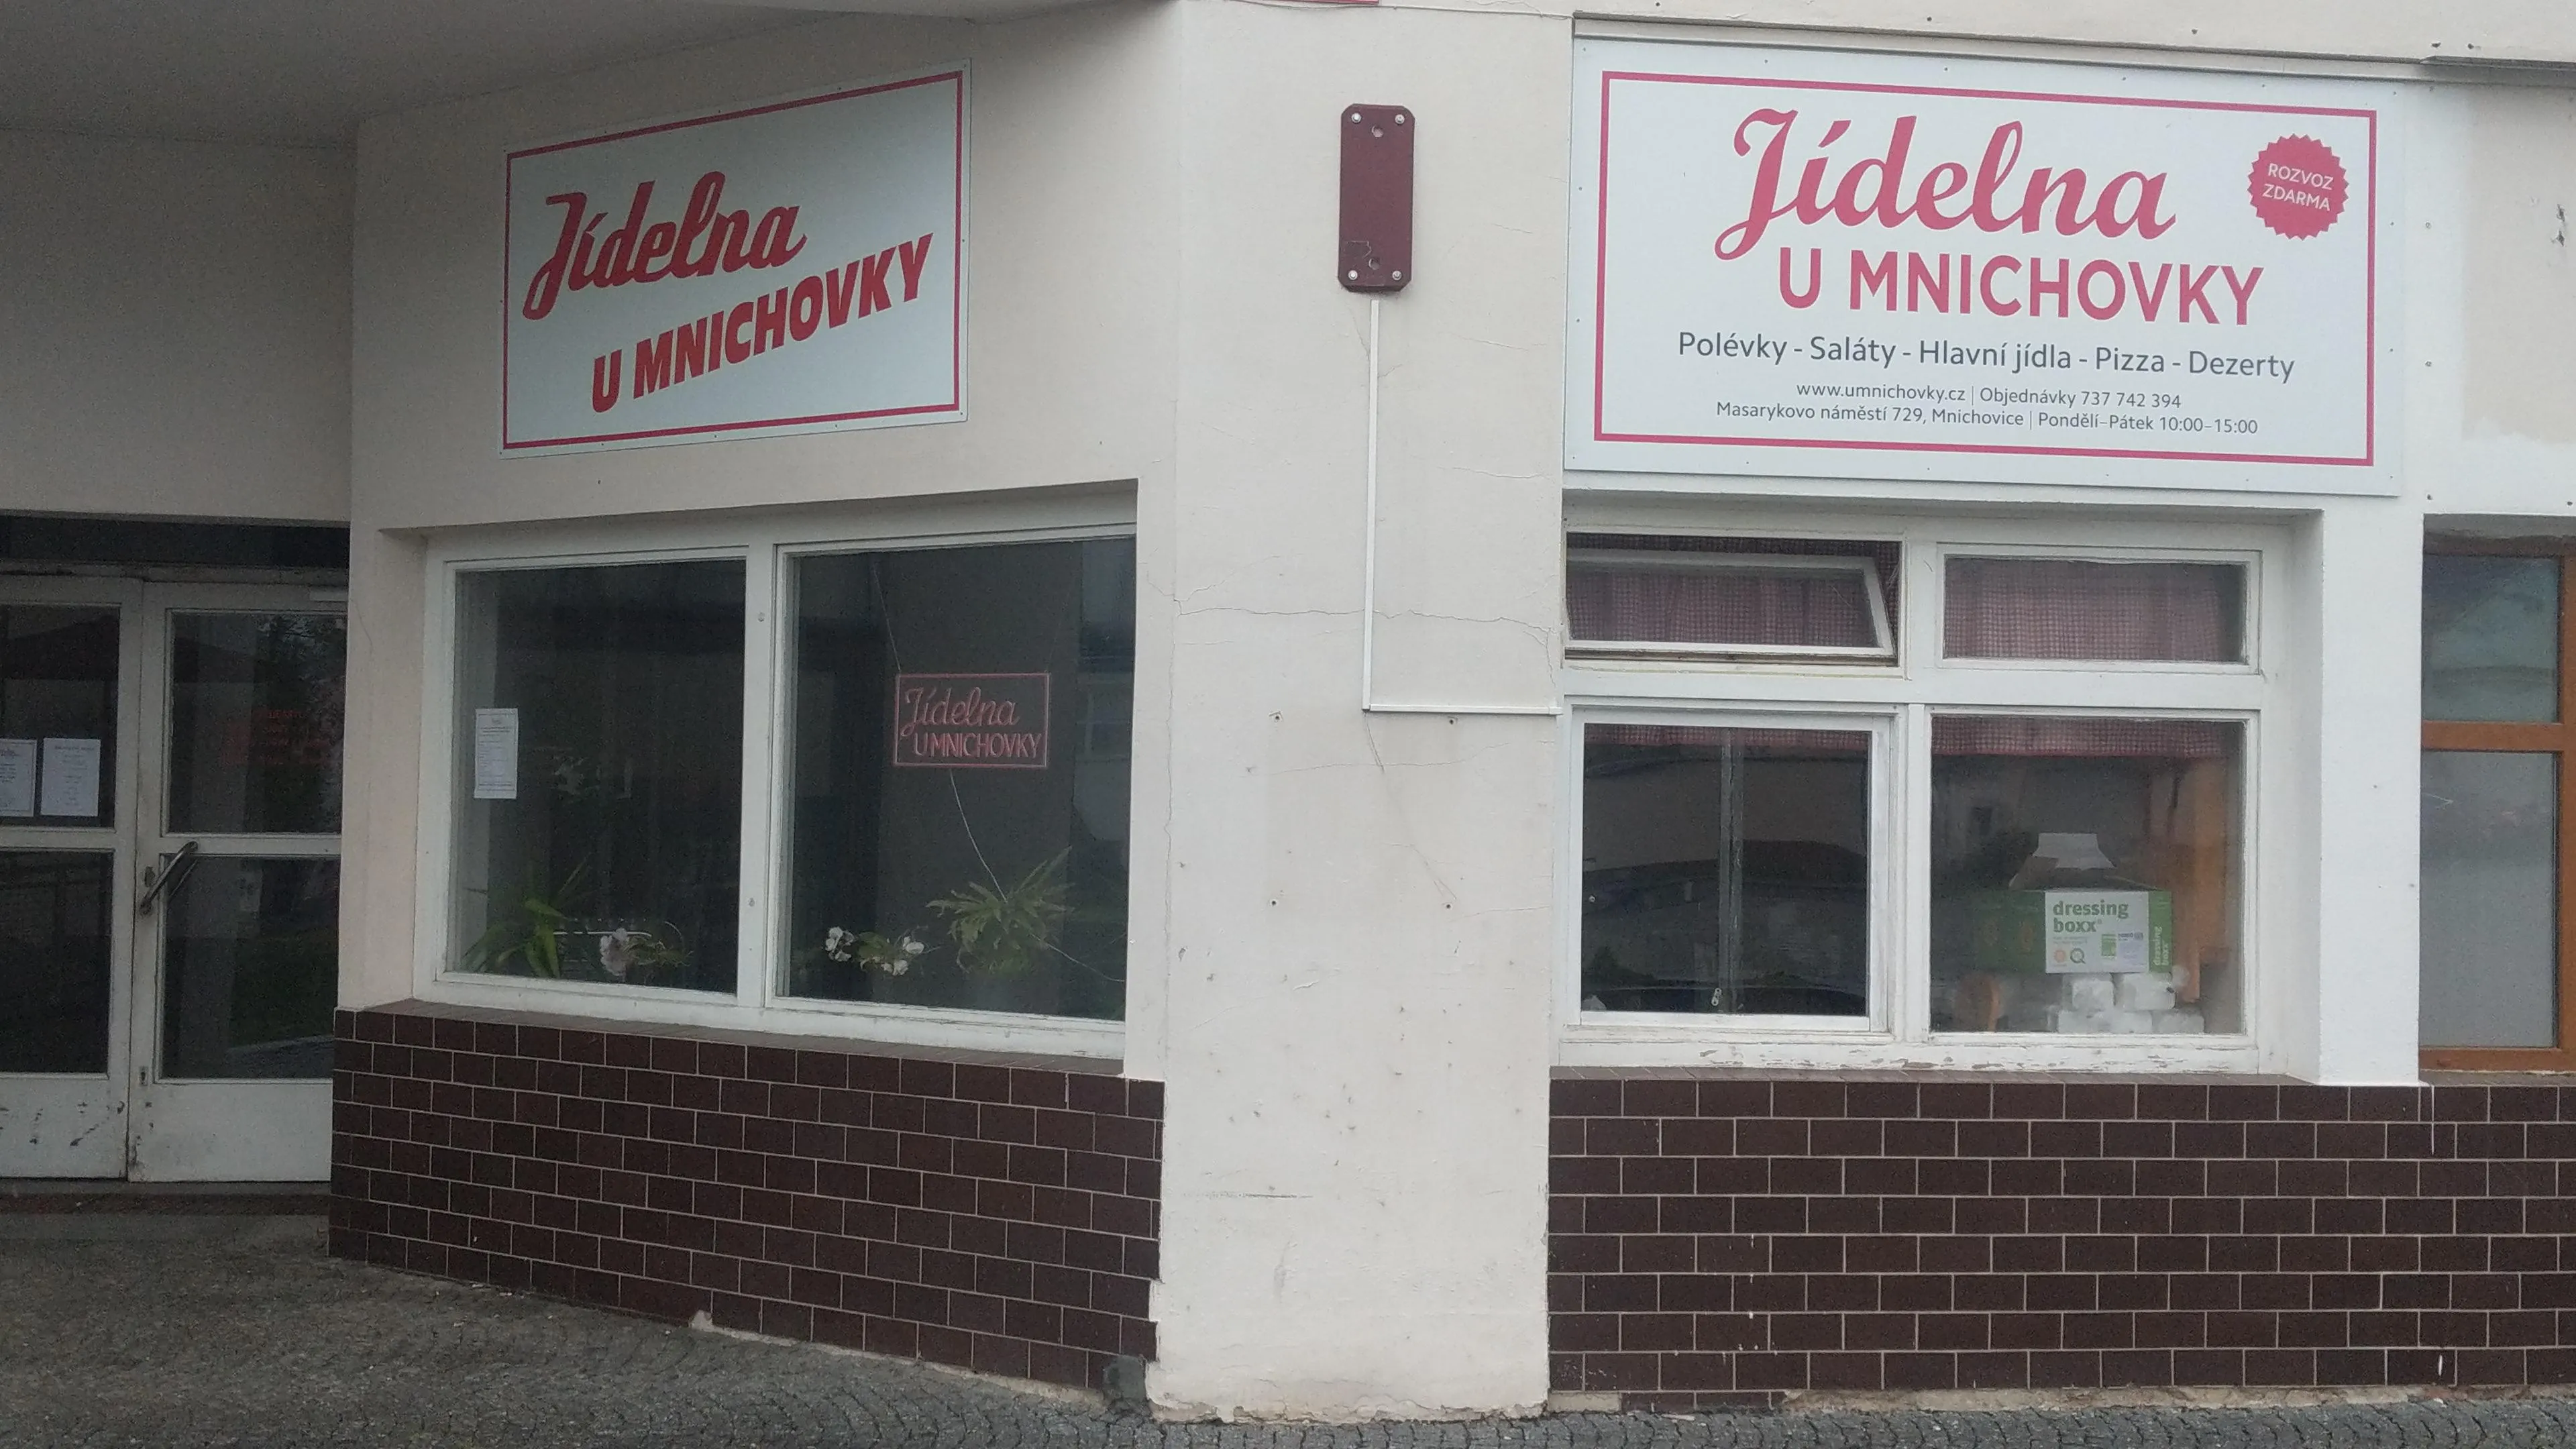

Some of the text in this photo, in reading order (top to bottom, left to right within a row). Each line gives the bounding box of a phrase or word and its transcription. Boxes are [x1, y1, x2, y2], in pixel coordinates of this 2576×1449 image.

[1715, 107, 2177, 260] Jídelna
[2262, 183, 2330, 212] ZDARMA
[2267, 162, 2334, 191] ROZVOZ
[523, 171, 807, 320] Jídelna
[1780, 248, 2264, 325] U MNICHOVKY
[592, 232, 933, 413] U MNICHOVKY
[1679, 331, 2294, 384] Polévky Saláty Hlavní jídla Pizza Dezerty
[1717, 401, 1815, 421] Masarykovo
[1821, 405, 1888, 421] náměstí
[1892, 407, 1926, 425] 729,
[1932, 409, 2024, 425] Mnichovice
[1796, 384, 2182, 409] www.umnichovky.cz Objednávky 737 742 394
[900, 687, 1020, 737] Jídelna
[2053, 899, 2129, 920] dressing
